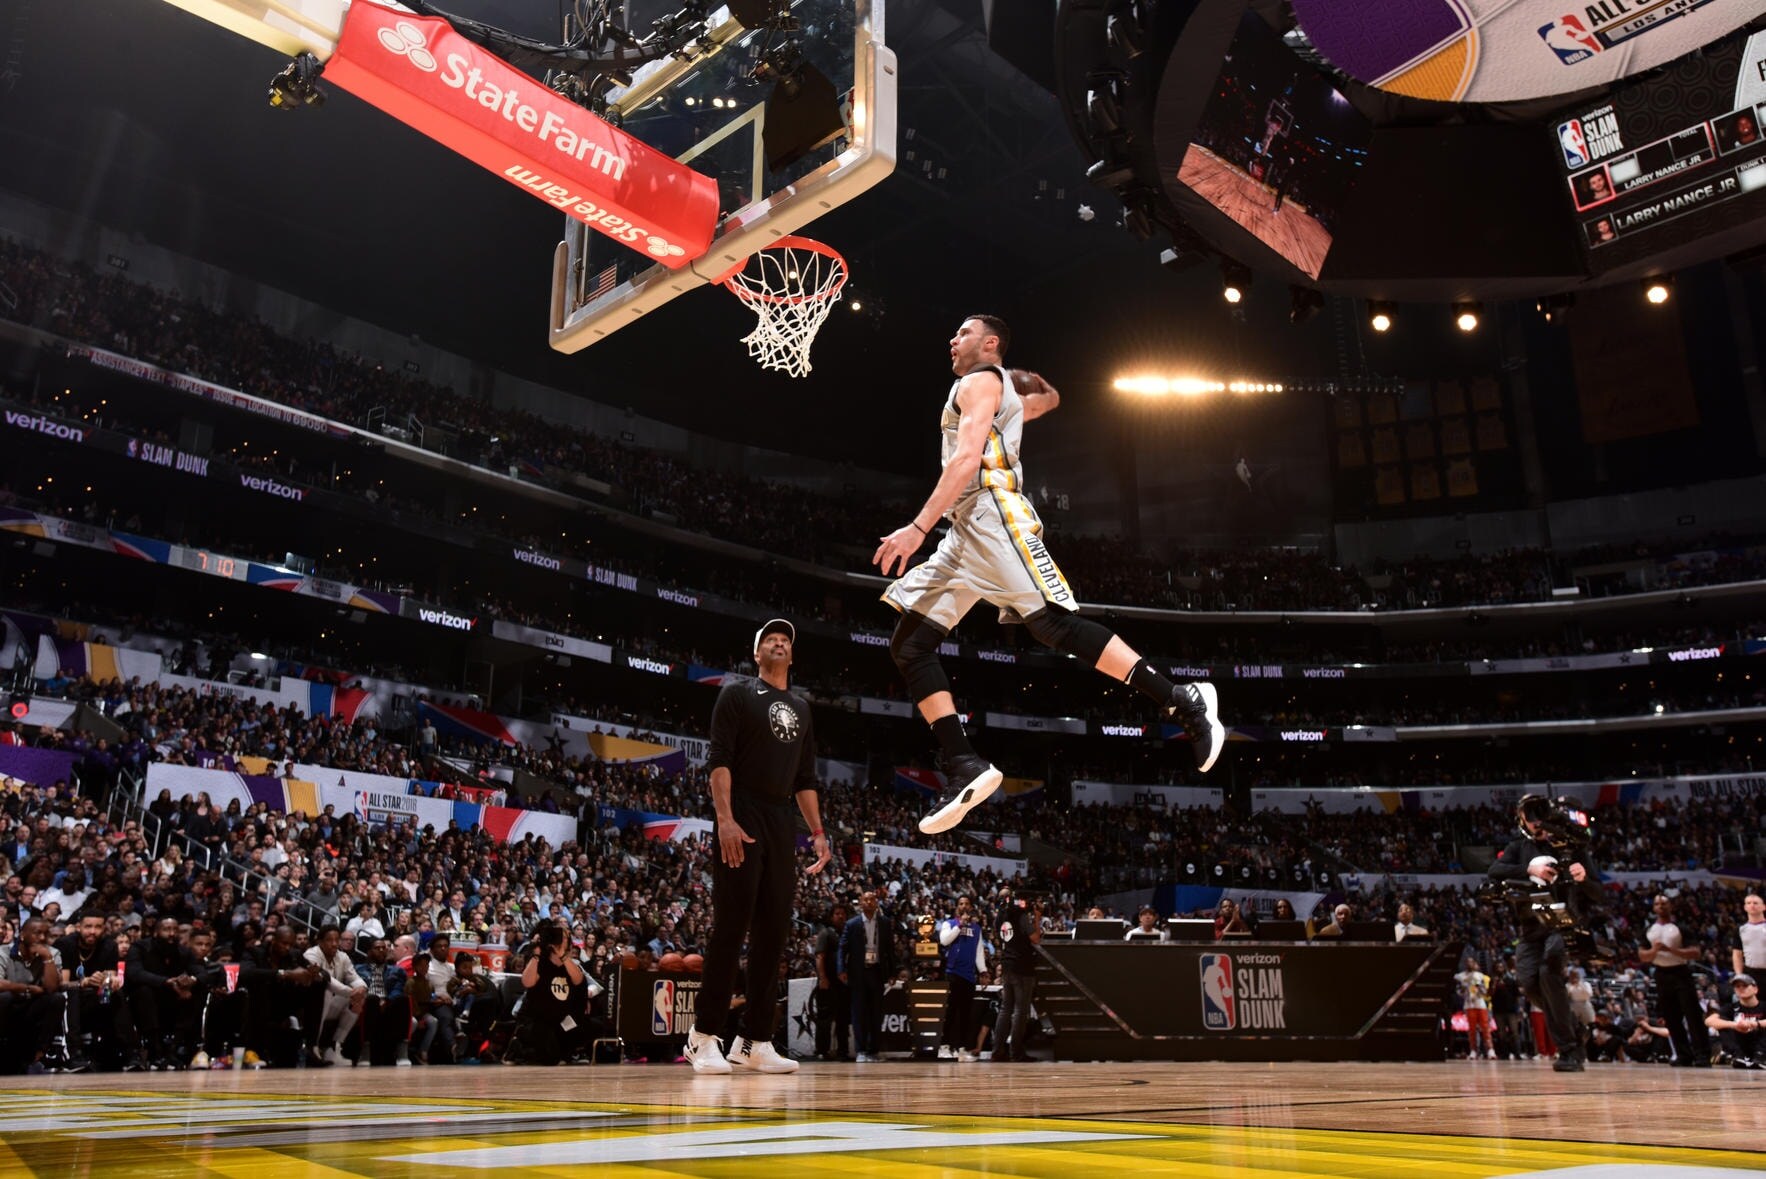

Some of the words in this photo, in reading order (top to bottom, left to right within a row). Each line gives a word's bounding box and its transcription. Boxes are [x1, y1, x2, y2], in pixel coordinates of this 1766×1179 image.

[1623, 14, 1658, 34] LOS
[1564, 50, 1588, 65] NBA
[1581, 104, 1613, 123] verizon
[1584, 113, 1619, 142] SLAM
[1589, 132, 1624, 160] DUNK
[1624, 172, 1654, 190] LARRY
[1655, 161, 1688, 179] NANCE
[1688, 155, 1702, 166] JR
[1616, 203, 1661, 230] LARRY
[1663, 185, 1713, 213] NANCE
[1718, 177, 1736, 193] JR
[90, 350, 146, 378] ASSISTANCE?
[146, 367, 167, 385] TEXT
[213, 389, 234, 406] ISSUE
[247, 402, 281, 421] LOCATION
[283, 411, 292, 422] TO
[5, 410, 84, 443] verizon
[141, 440, 173, 467] SLAM
[176, 452, 210, 478] DUNK
[240, 474, 303, 502] verizon
[513, 547, 560, 571] verizon
[1025, 536, 1070, 603] CLEVELAND
[595, 566, 616, 589] SLAM
[617, 572, 638, 593] DUNK
[657, 585, 698, 608] verizon
[419, 607, 471, 631] verizon
[850, 631, 890, 647] verizon
[977, 648, 1016, 664] verizon
[1668, 646, 1721, 662] verizon
[628, 655, 670, 676] verizon
[1170, 664, 1210, 678] verizon
[1242, 664, 1262, 678] SLAM
[1263, 664, 1283, 678] DUNK
[1303, 666, 1345, 679] verizon
[1102, 724, 1143, 738] verizon
[1281, 728, 1325, 741] verizon
[680, 739, 703, 760] STAR
[369, 792, 381, 807] ALL
[382, 793, 402, 810] STAR
[492, 956, 503, 968] G
[1236, 952, 1281, 964] verizon
[551, 983, 568, 994] TNT
[1237, 968, 1284, 999] SLAM
[607, 973, 615, 1019] verizon
[675, 990, 698, 1013] SLA
[1207, 1012, 1224, 1025] NBA
[1240, 1000, 1287, 1029] DUNK
